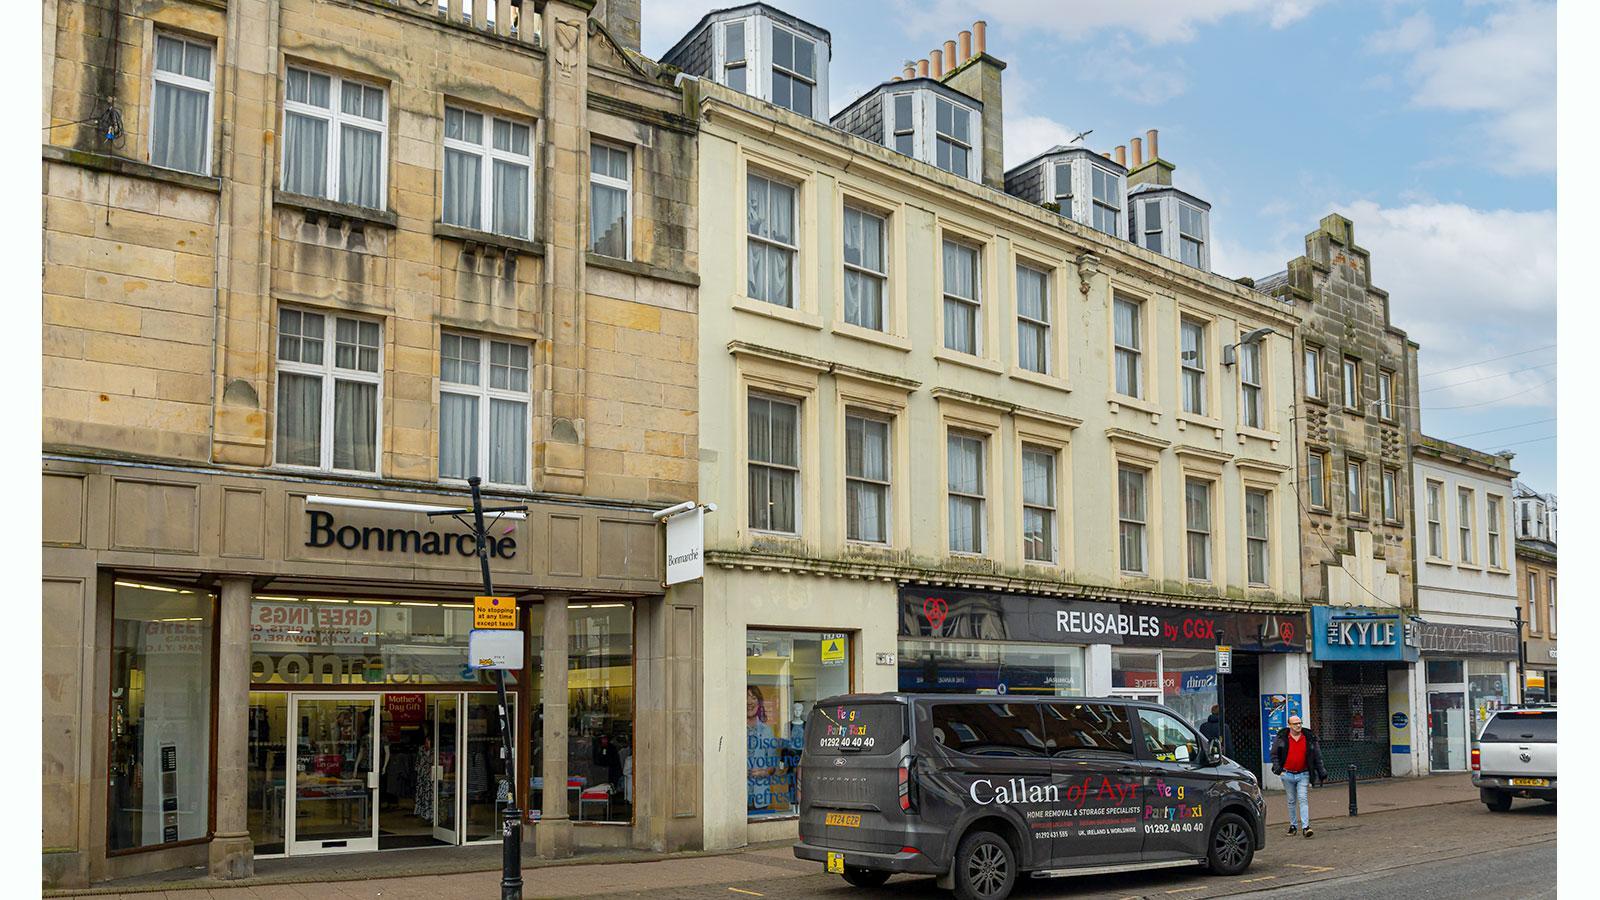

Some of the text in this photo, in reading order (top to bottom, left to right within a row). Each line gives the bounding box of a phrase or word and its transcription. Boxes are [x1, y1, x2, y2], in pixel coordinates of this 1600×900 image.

[668, 547, 699, 567] Bonmarché
[1056, 610, 1215, 641] REUSABLES by CGX
[1327, 621, 1339, 645] THE
[1338, 622, 1397, 646] KYLE
[388, 694, 422, 703] Mother's
[388, 703, 421, 712] Day Gift
[827, 724, 867, 737] Party Taxi
[820, 737, 875, 747] 01292 40 40 40
[784, 755, 801, 768] ne
[969, 776, 1140, 808] Callan of Ayr
[1027, 811, 1045, 819] HOME
[1045, 809, 1073, 818] REMOVAL
[1079, 808, 1105, 816] STORAGE
[1106, 806, 1141, 815] SPECIALISTS
[1143, 803, 1203, 821] Party Taxi
[1111, 826, 1137, 835] WORLDWIDE
[1144, 822, 1204, 834] 01292 40 40 40
